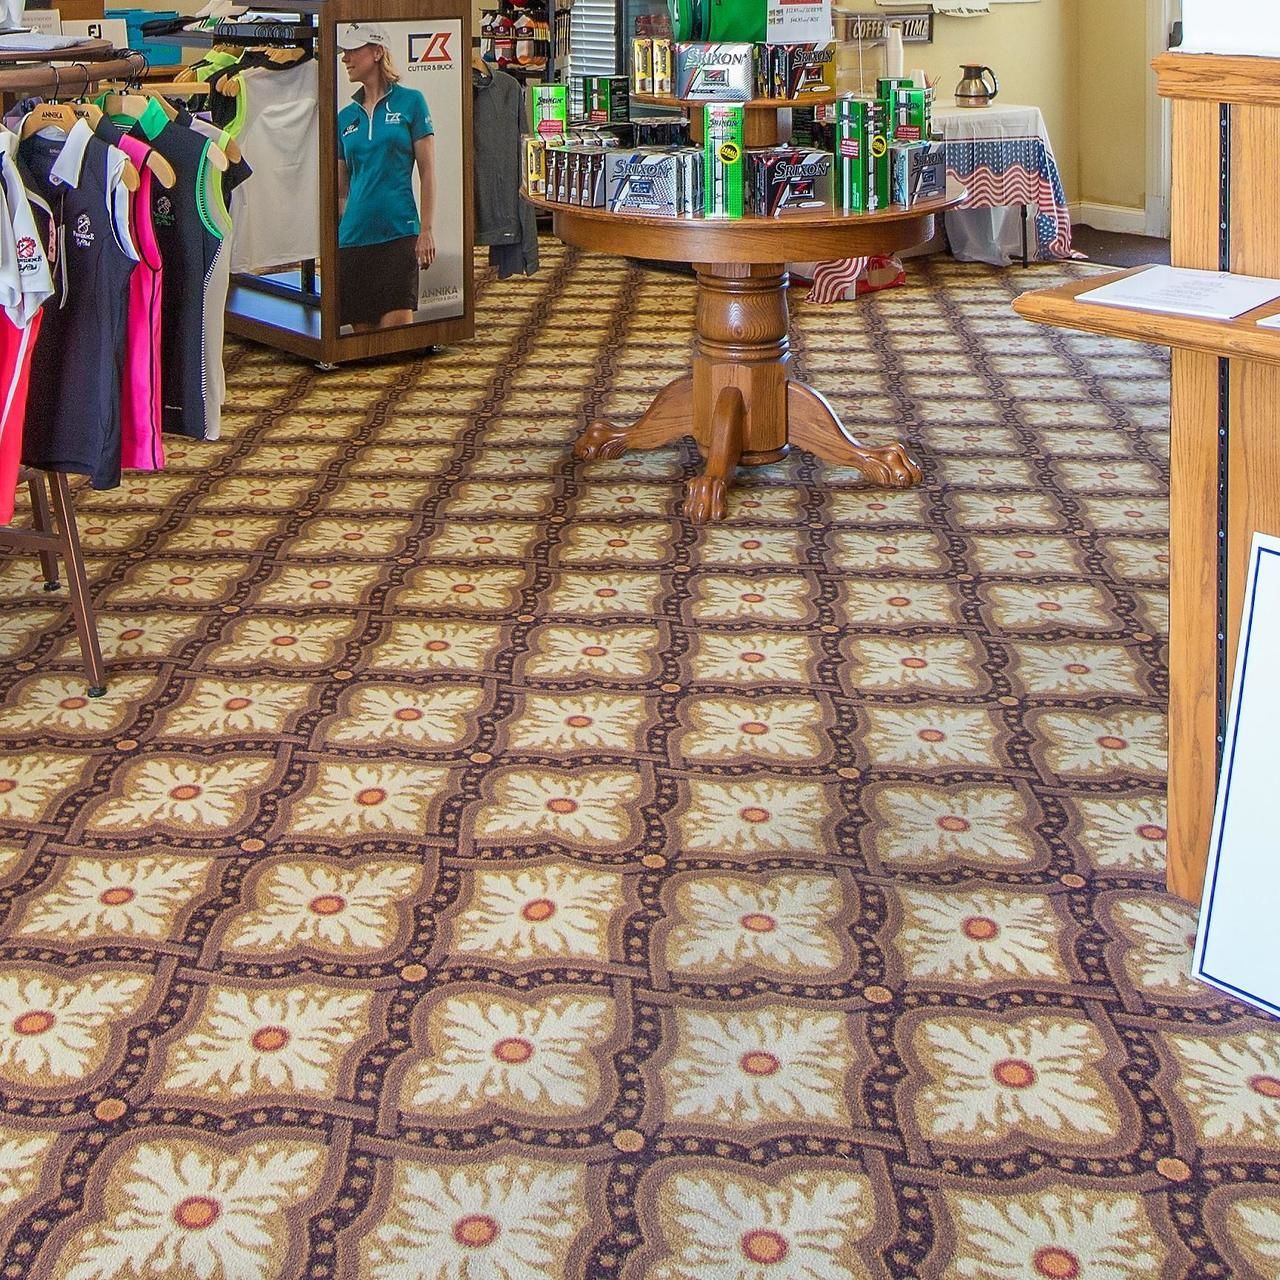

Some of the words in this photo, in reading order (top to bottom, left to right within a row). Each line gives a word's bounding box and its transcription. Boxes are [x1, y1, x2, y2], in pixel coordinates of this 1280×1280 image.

[88, 24, 102, 38] FJ
[905, 20, 928, 36] TIME
[685, 48, 747, 69] SRIXON
[793, 48, 834, 68] SRIXON
[42, 111, 63, 119] ANNIKA
[610, 159, 670, 182] SRIXON
[772, 161, 830, 184] SRIXON
[422, 286, 458, 298] ANNIKA
